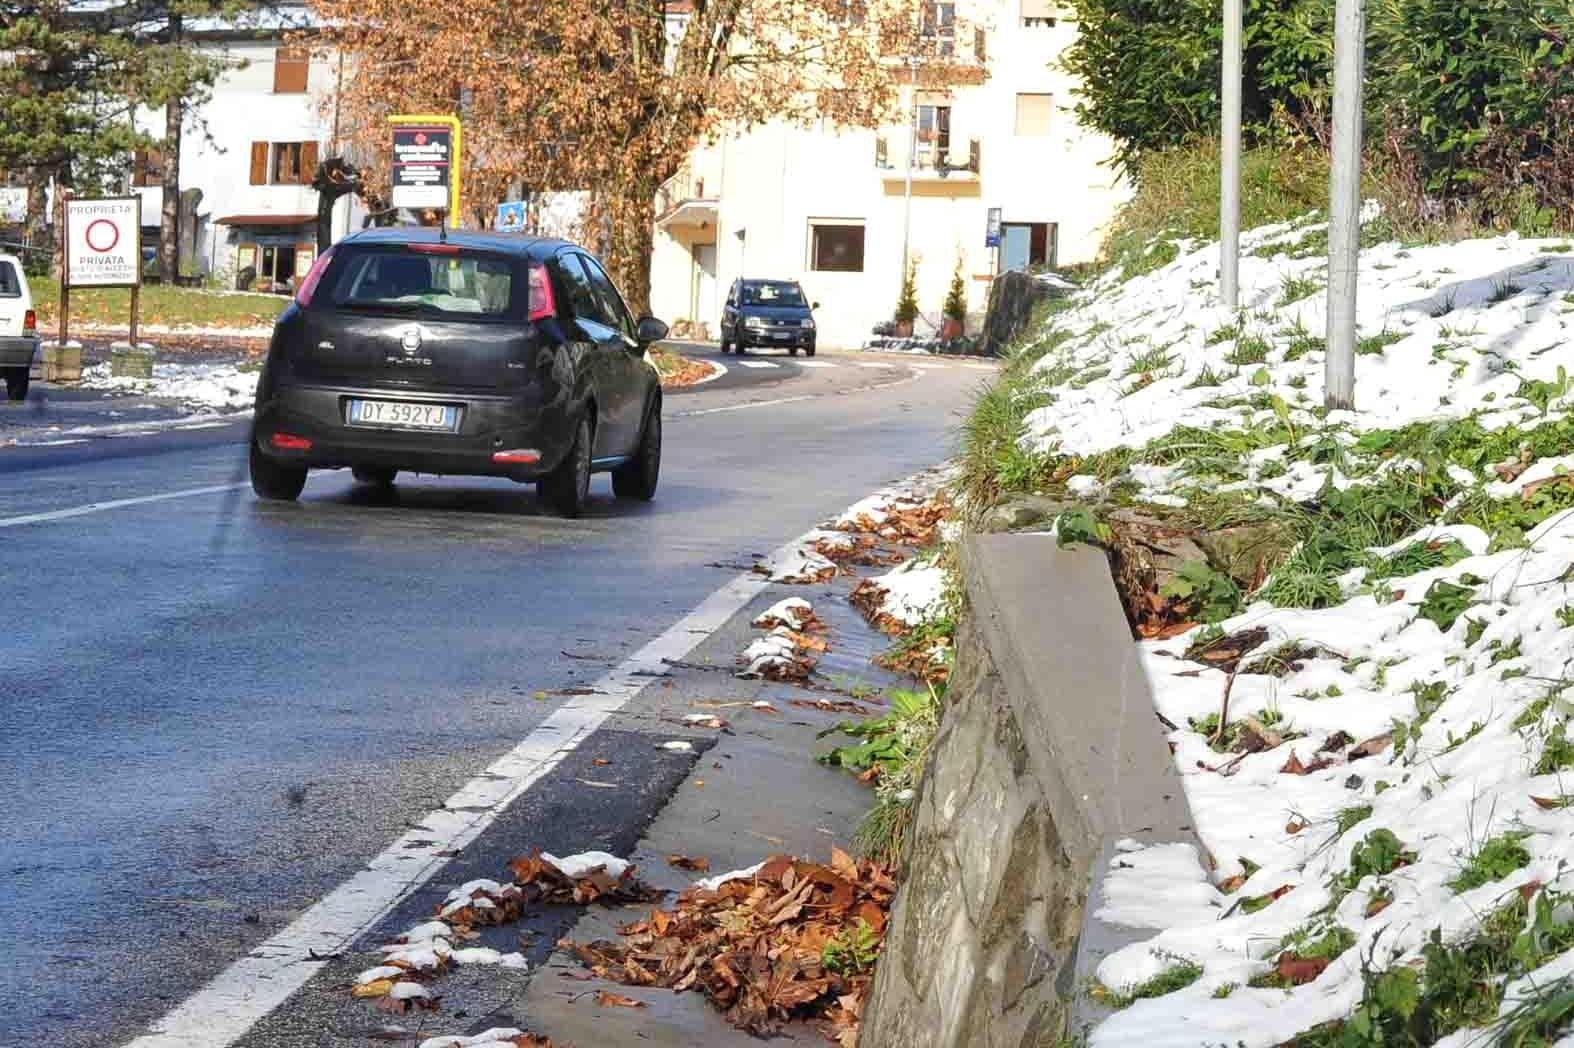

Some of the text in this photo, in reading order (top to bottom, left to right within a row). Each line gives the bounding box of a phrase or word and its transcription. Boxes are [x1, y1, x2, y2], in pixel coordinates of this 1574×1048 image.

[79, 255, 125, 265] PRIVATA
[362, 402, 445, 425] DY 592YJ
